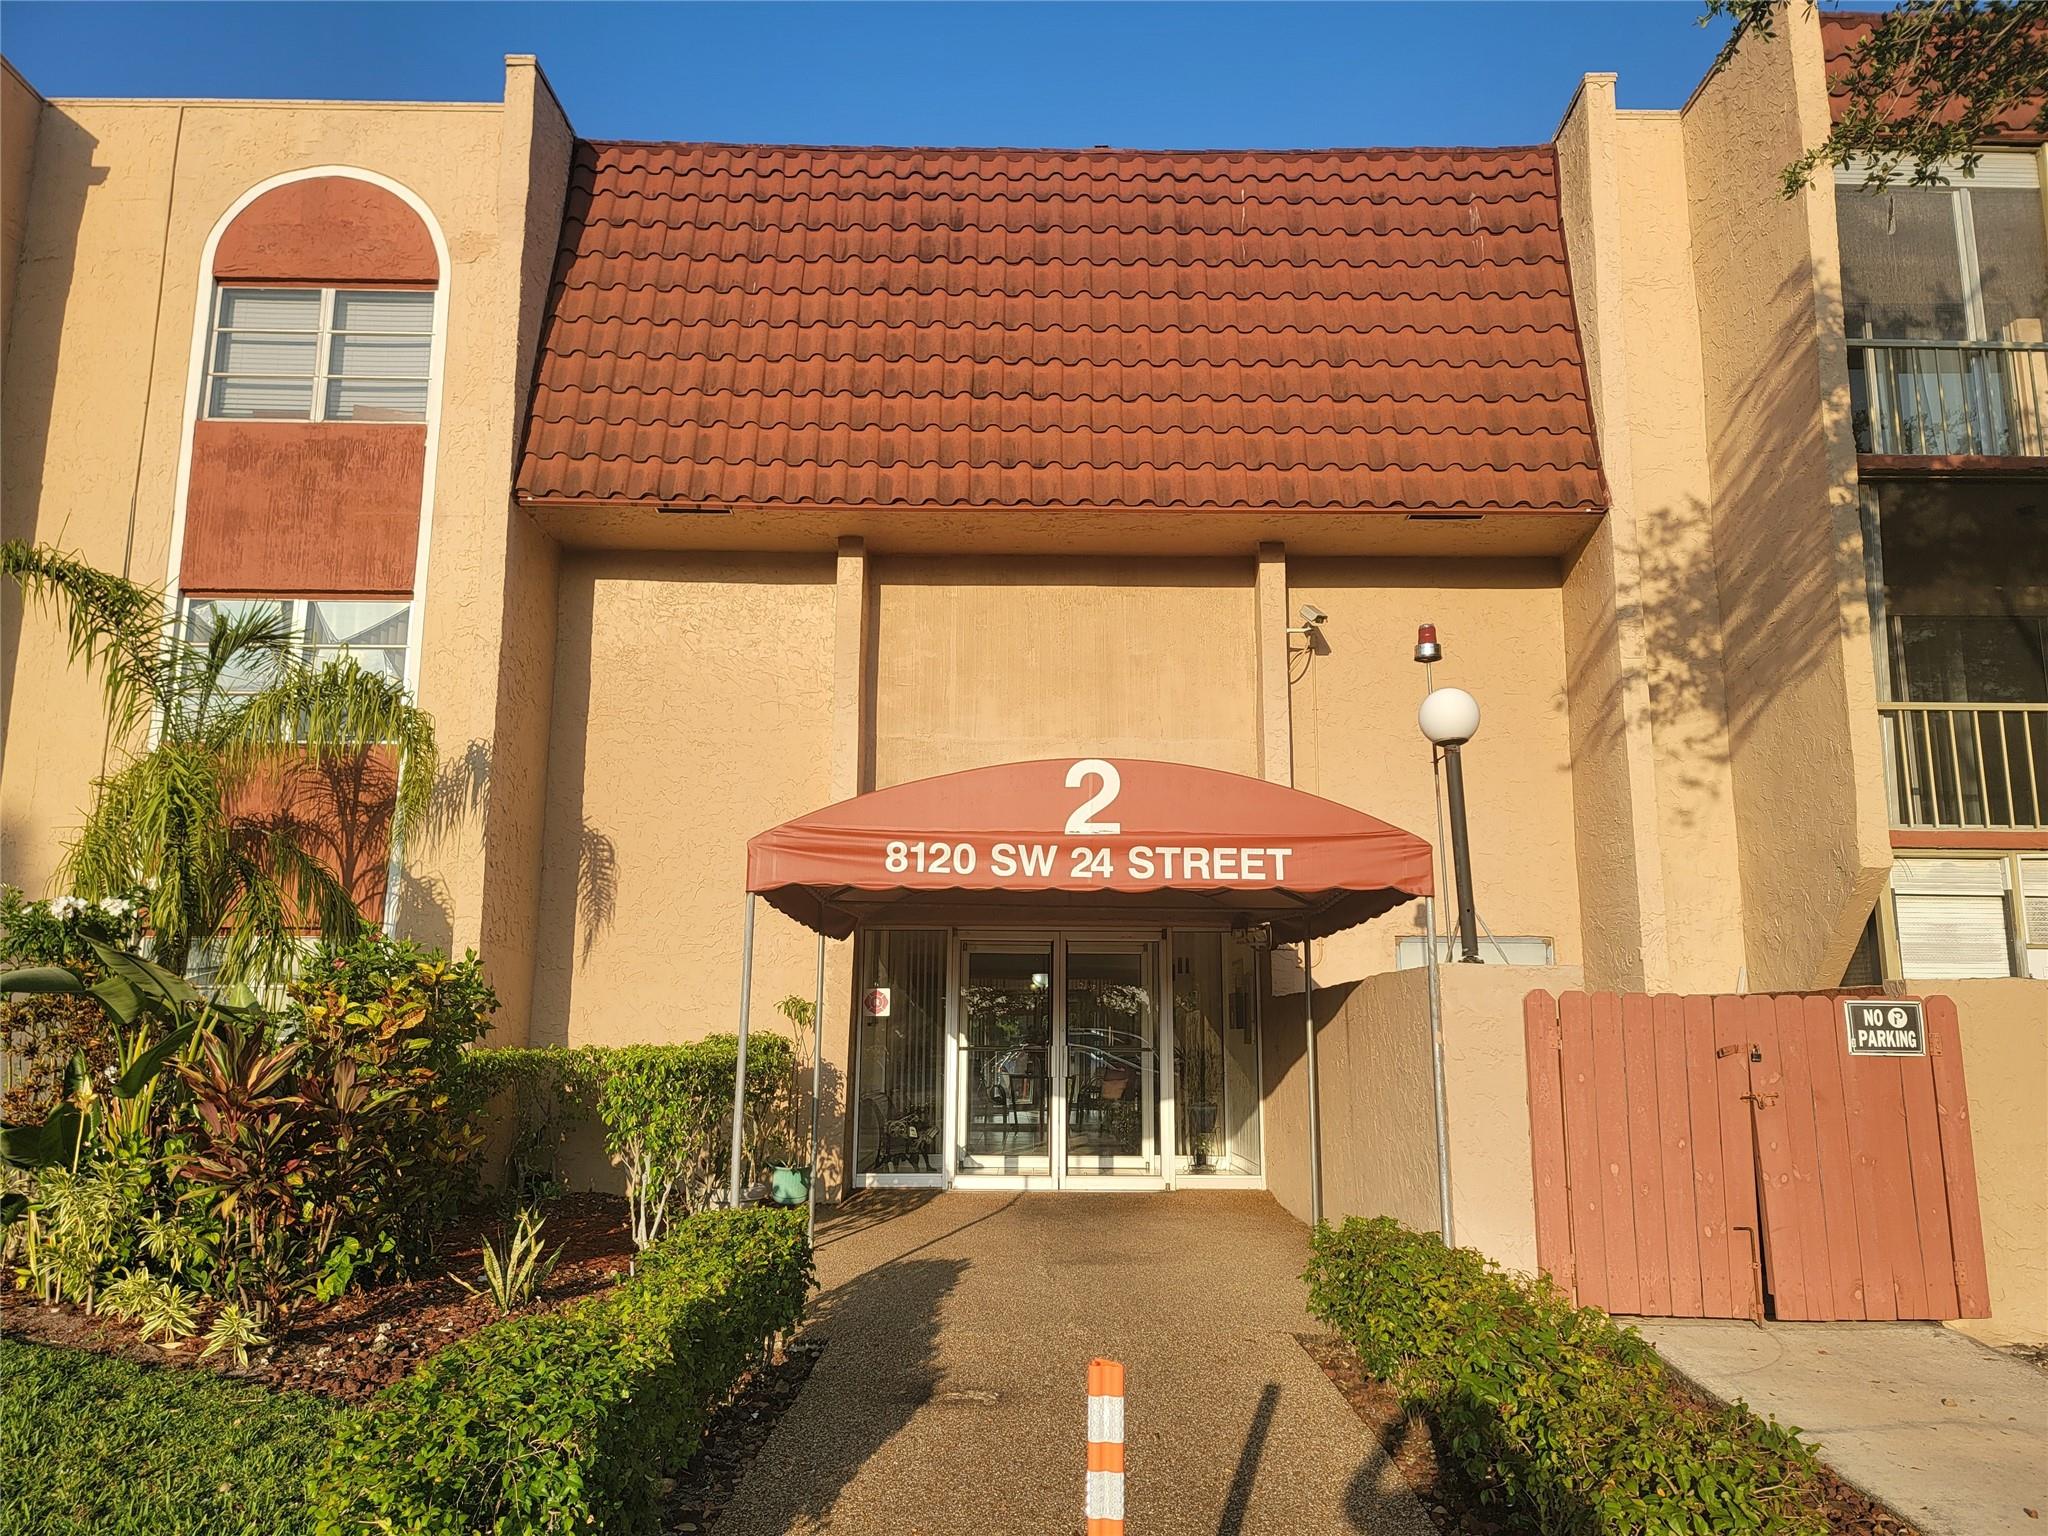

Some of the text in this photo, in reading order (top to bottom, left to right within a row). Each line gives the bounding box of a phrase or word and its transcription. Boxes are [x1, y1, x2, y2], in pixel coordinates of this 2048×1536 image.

[1064, 759, 1121, 835] 2
[884, 841, 1293, 881] 8120 SW 24 STREET
[1863, 1009, 1883, 1026] NO
[1858, 1030, 1917, 1048] PARKING
